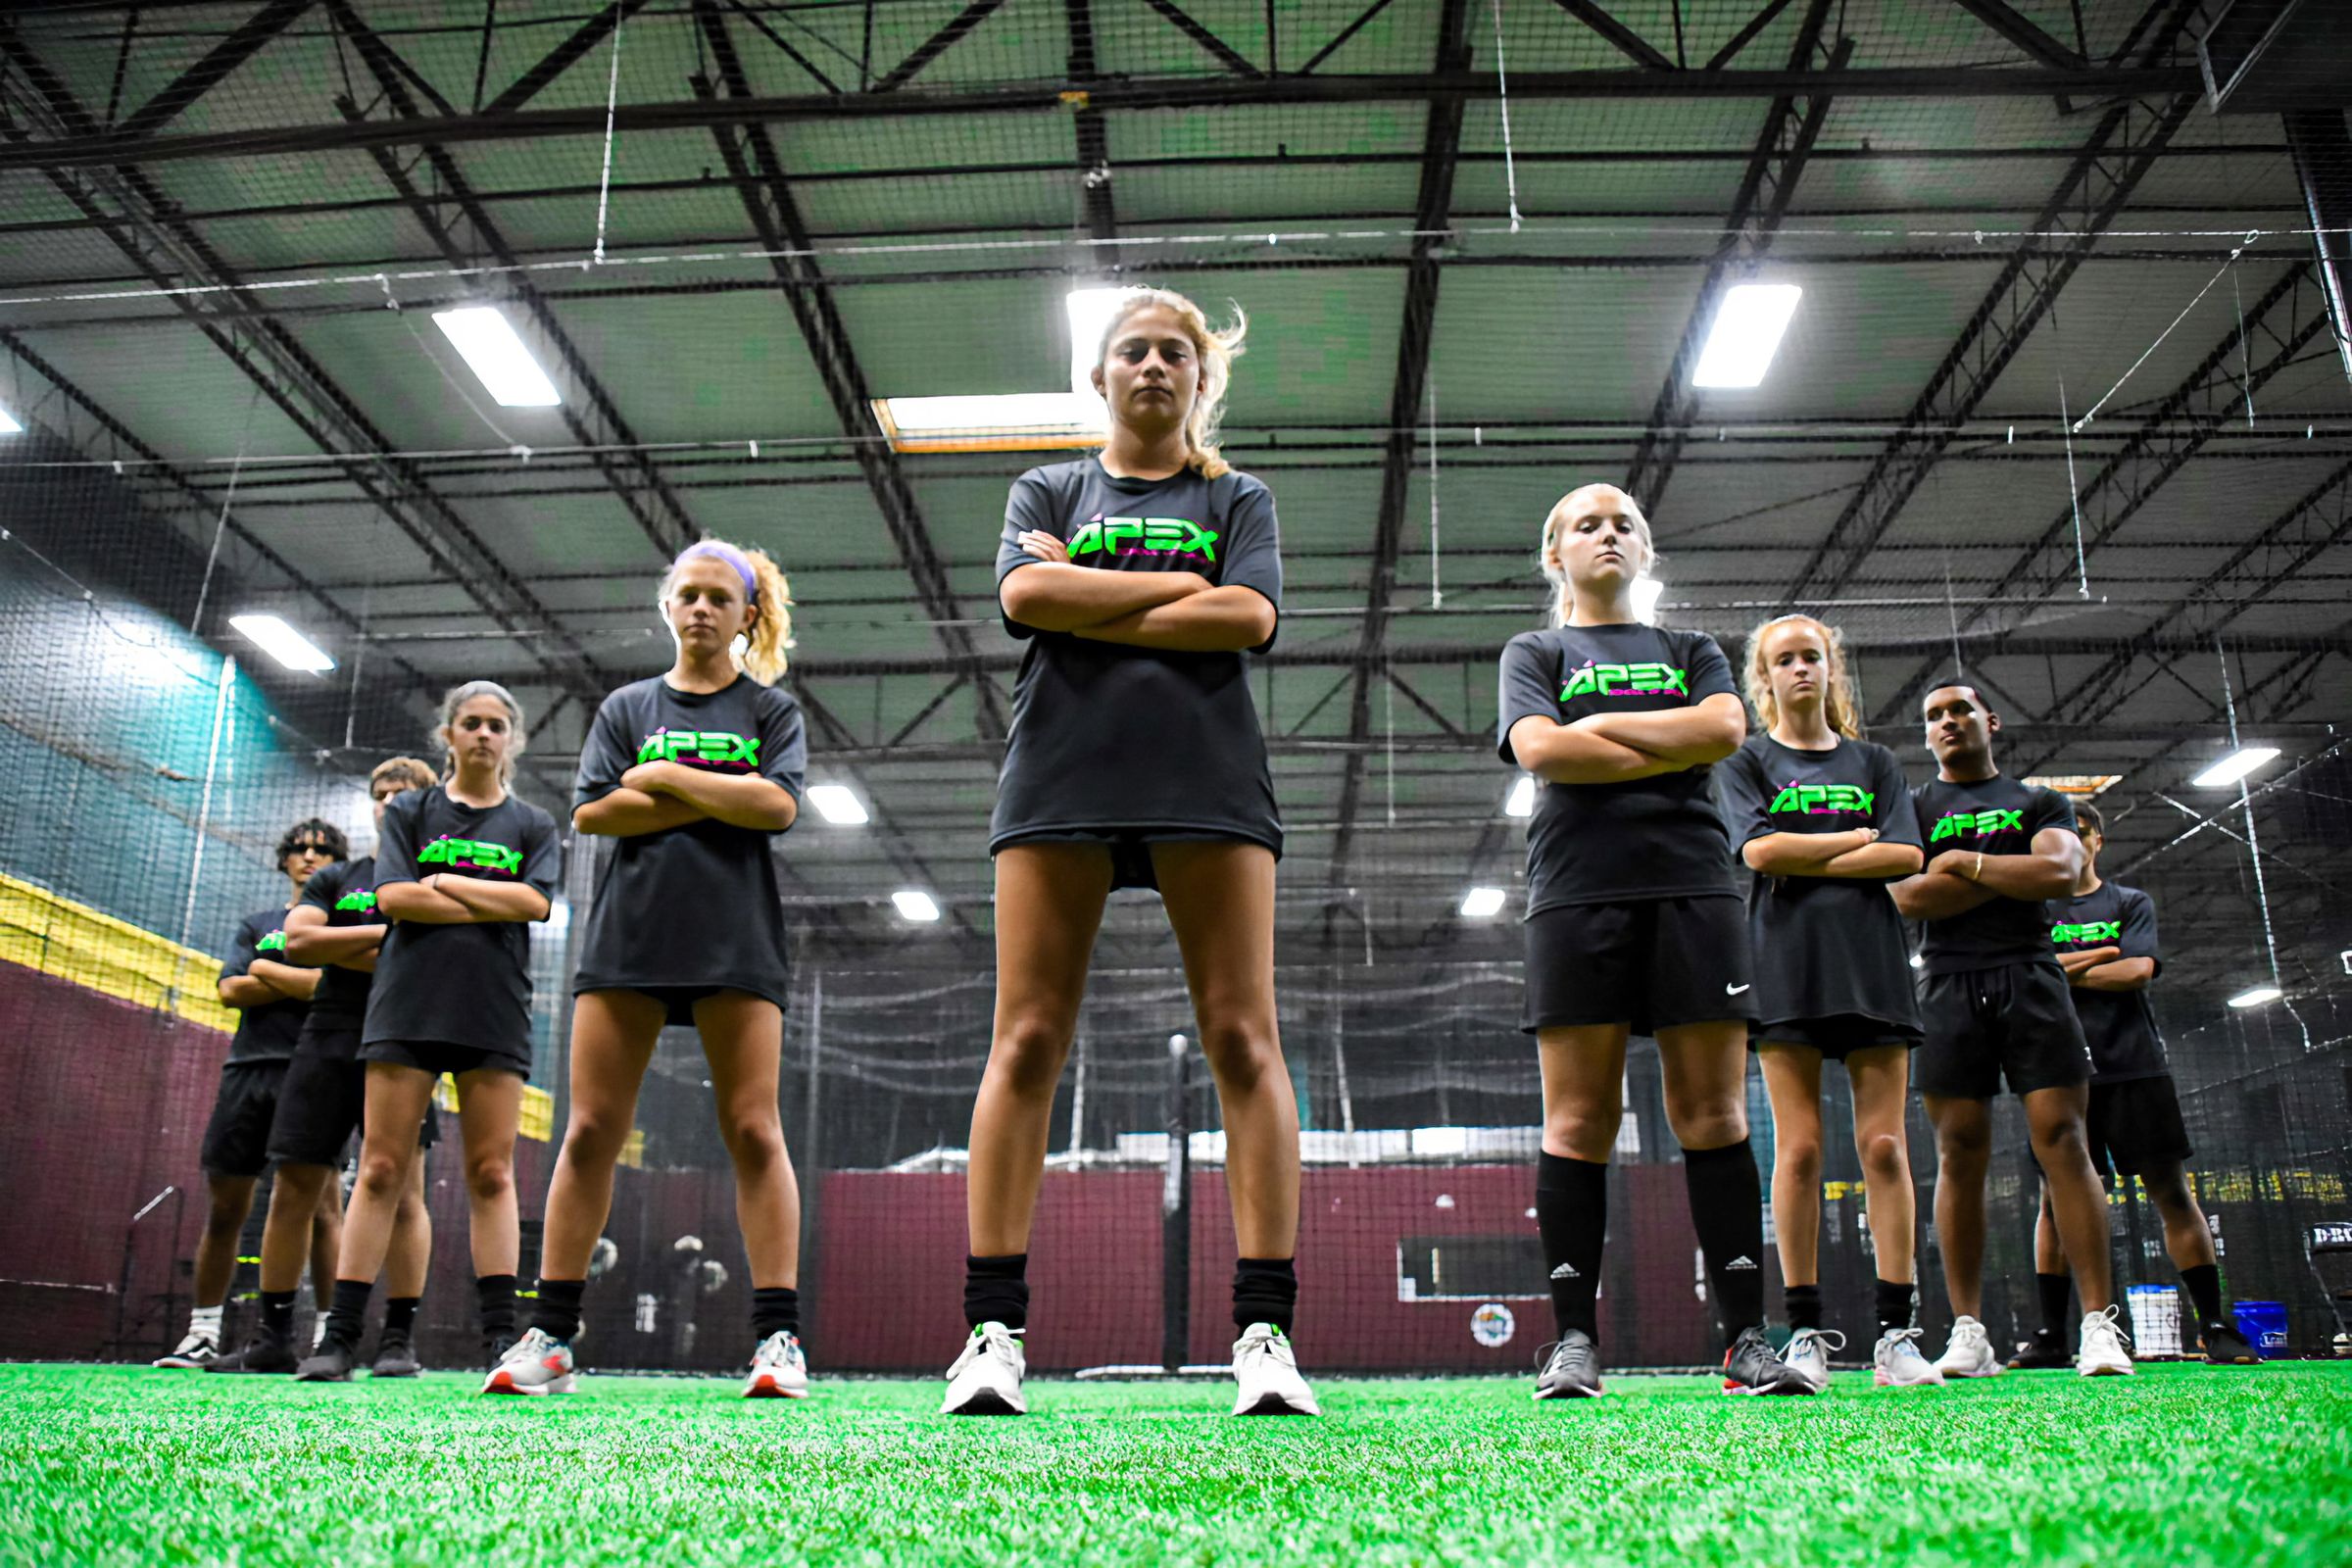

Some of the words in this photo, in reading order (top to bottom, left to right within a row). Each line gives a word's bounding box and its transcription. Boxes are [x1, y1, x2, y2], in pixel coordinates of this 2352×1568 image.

[1066, 517, 1219, 562] APEX
[1560, 662, 1690, 703] APEX
[637, 730, 761, 766] APEX
[1769, 784, 1875, 815] APEX
[1930, 808, 2024, 843] APEX
[416, 837, 524, 875] APEX
[2050, 920, 2122, 943] APEX
